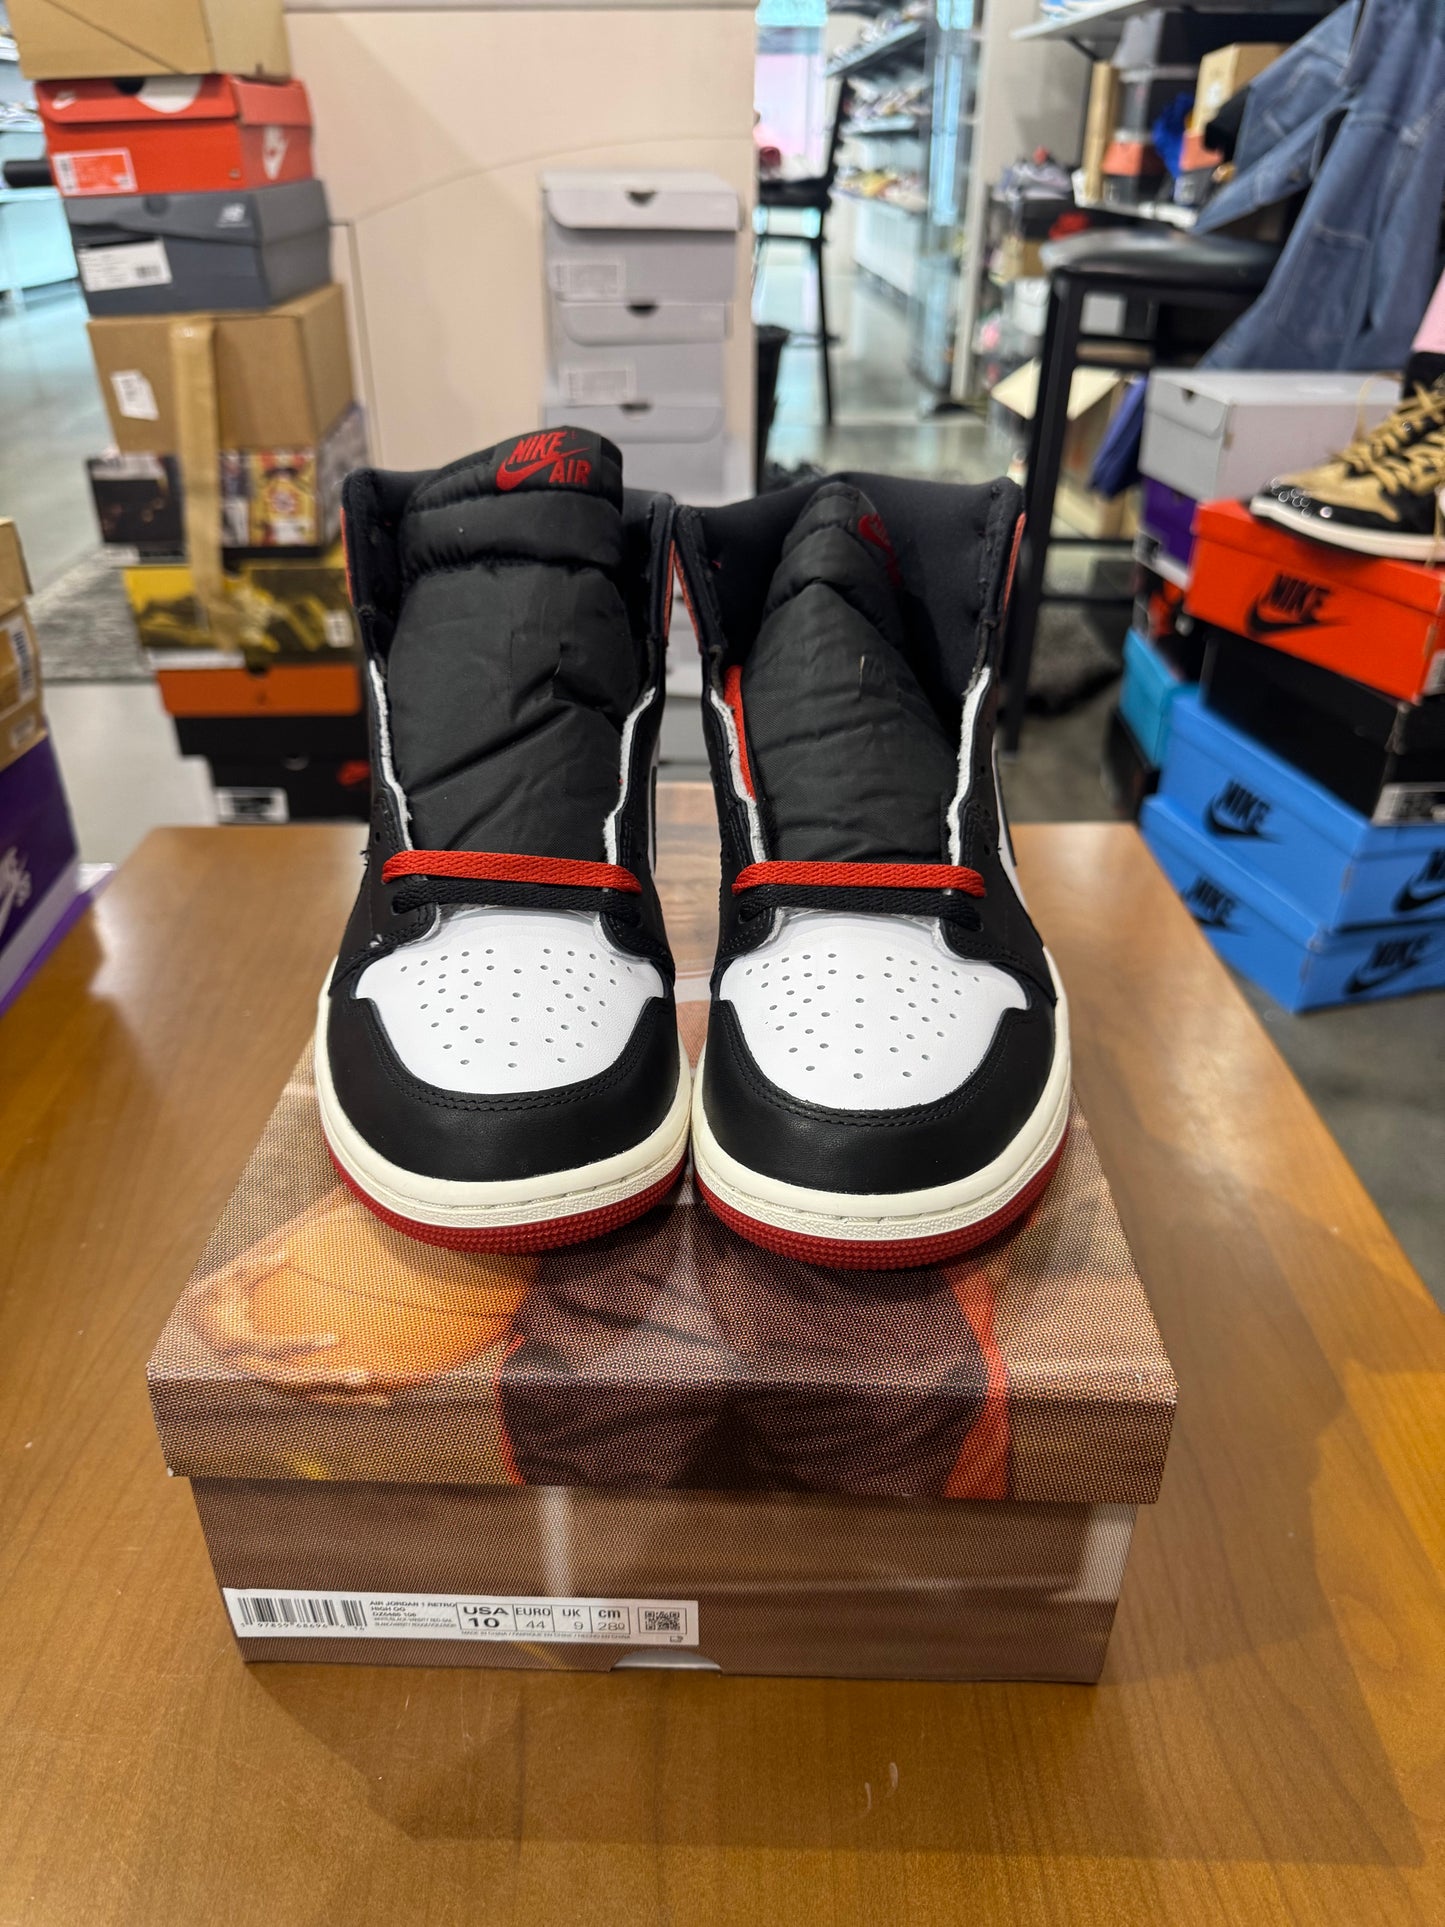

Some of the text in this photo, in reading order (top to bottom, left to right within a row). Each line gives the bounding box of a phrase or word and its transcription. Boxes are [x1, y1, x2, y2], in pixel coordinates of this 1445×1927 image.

[507, 431, 567, 466] NIKE
[548, 457, 592, 487] AIR
[1264, 573, 1331, 619] NIKE
[1218, 780, 1271, 833] NIKE
[463, 1606, 621, 1618] USA EURO UK cm
[468, 1617, 500, 1628] 10
[526, 1620, 545, 1629] 44
[574, 1621, 584, 1631] 9
